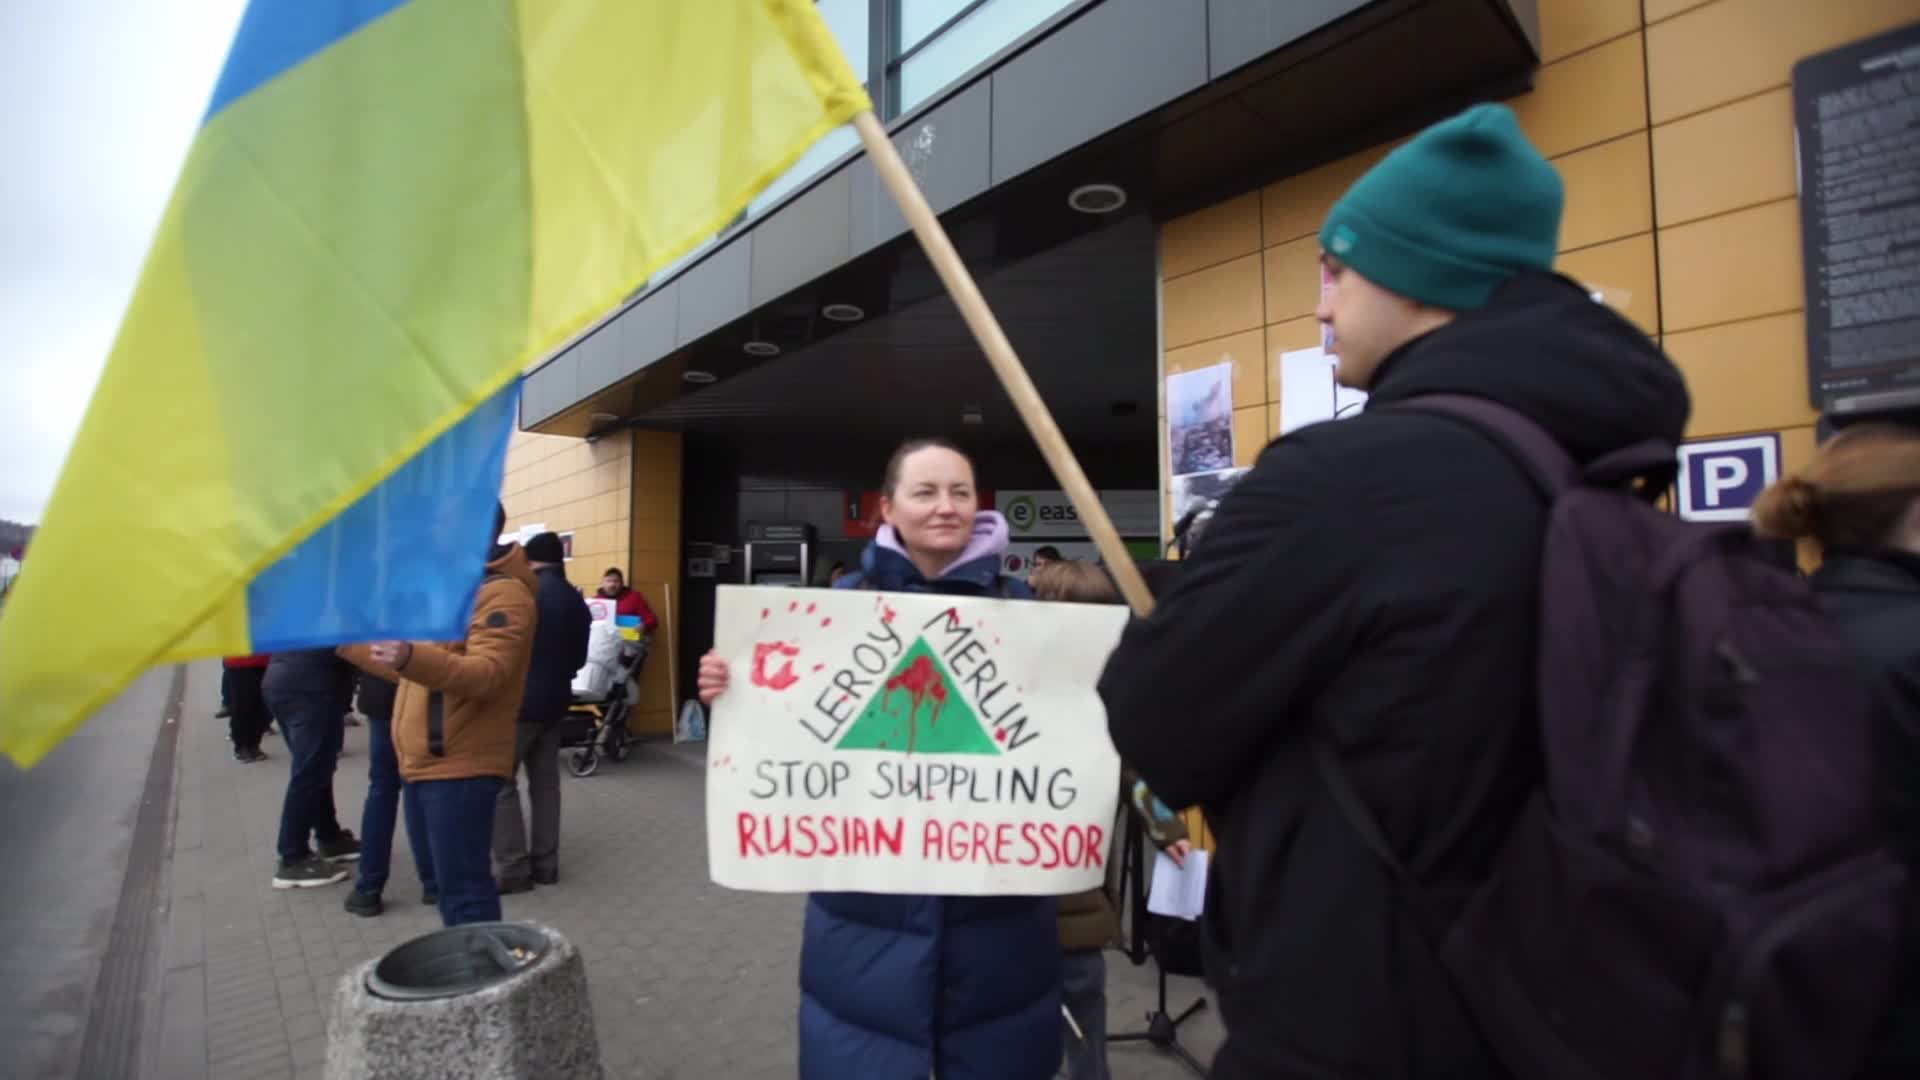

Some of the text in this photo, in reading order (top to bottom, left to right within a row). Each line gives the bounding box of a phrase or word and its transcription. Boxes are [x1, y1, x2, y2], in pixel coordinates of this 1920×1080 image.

[1703, 456, 1748, 506] P
[1040, 504, 1078, 520] eas
[799, 607, 1041, 752] LEROY MERLIN
[750, 759, 1078, 810] STOP SUPPLING
[737, 812, 1104, 871] RUSSIAN AGRESSOR
